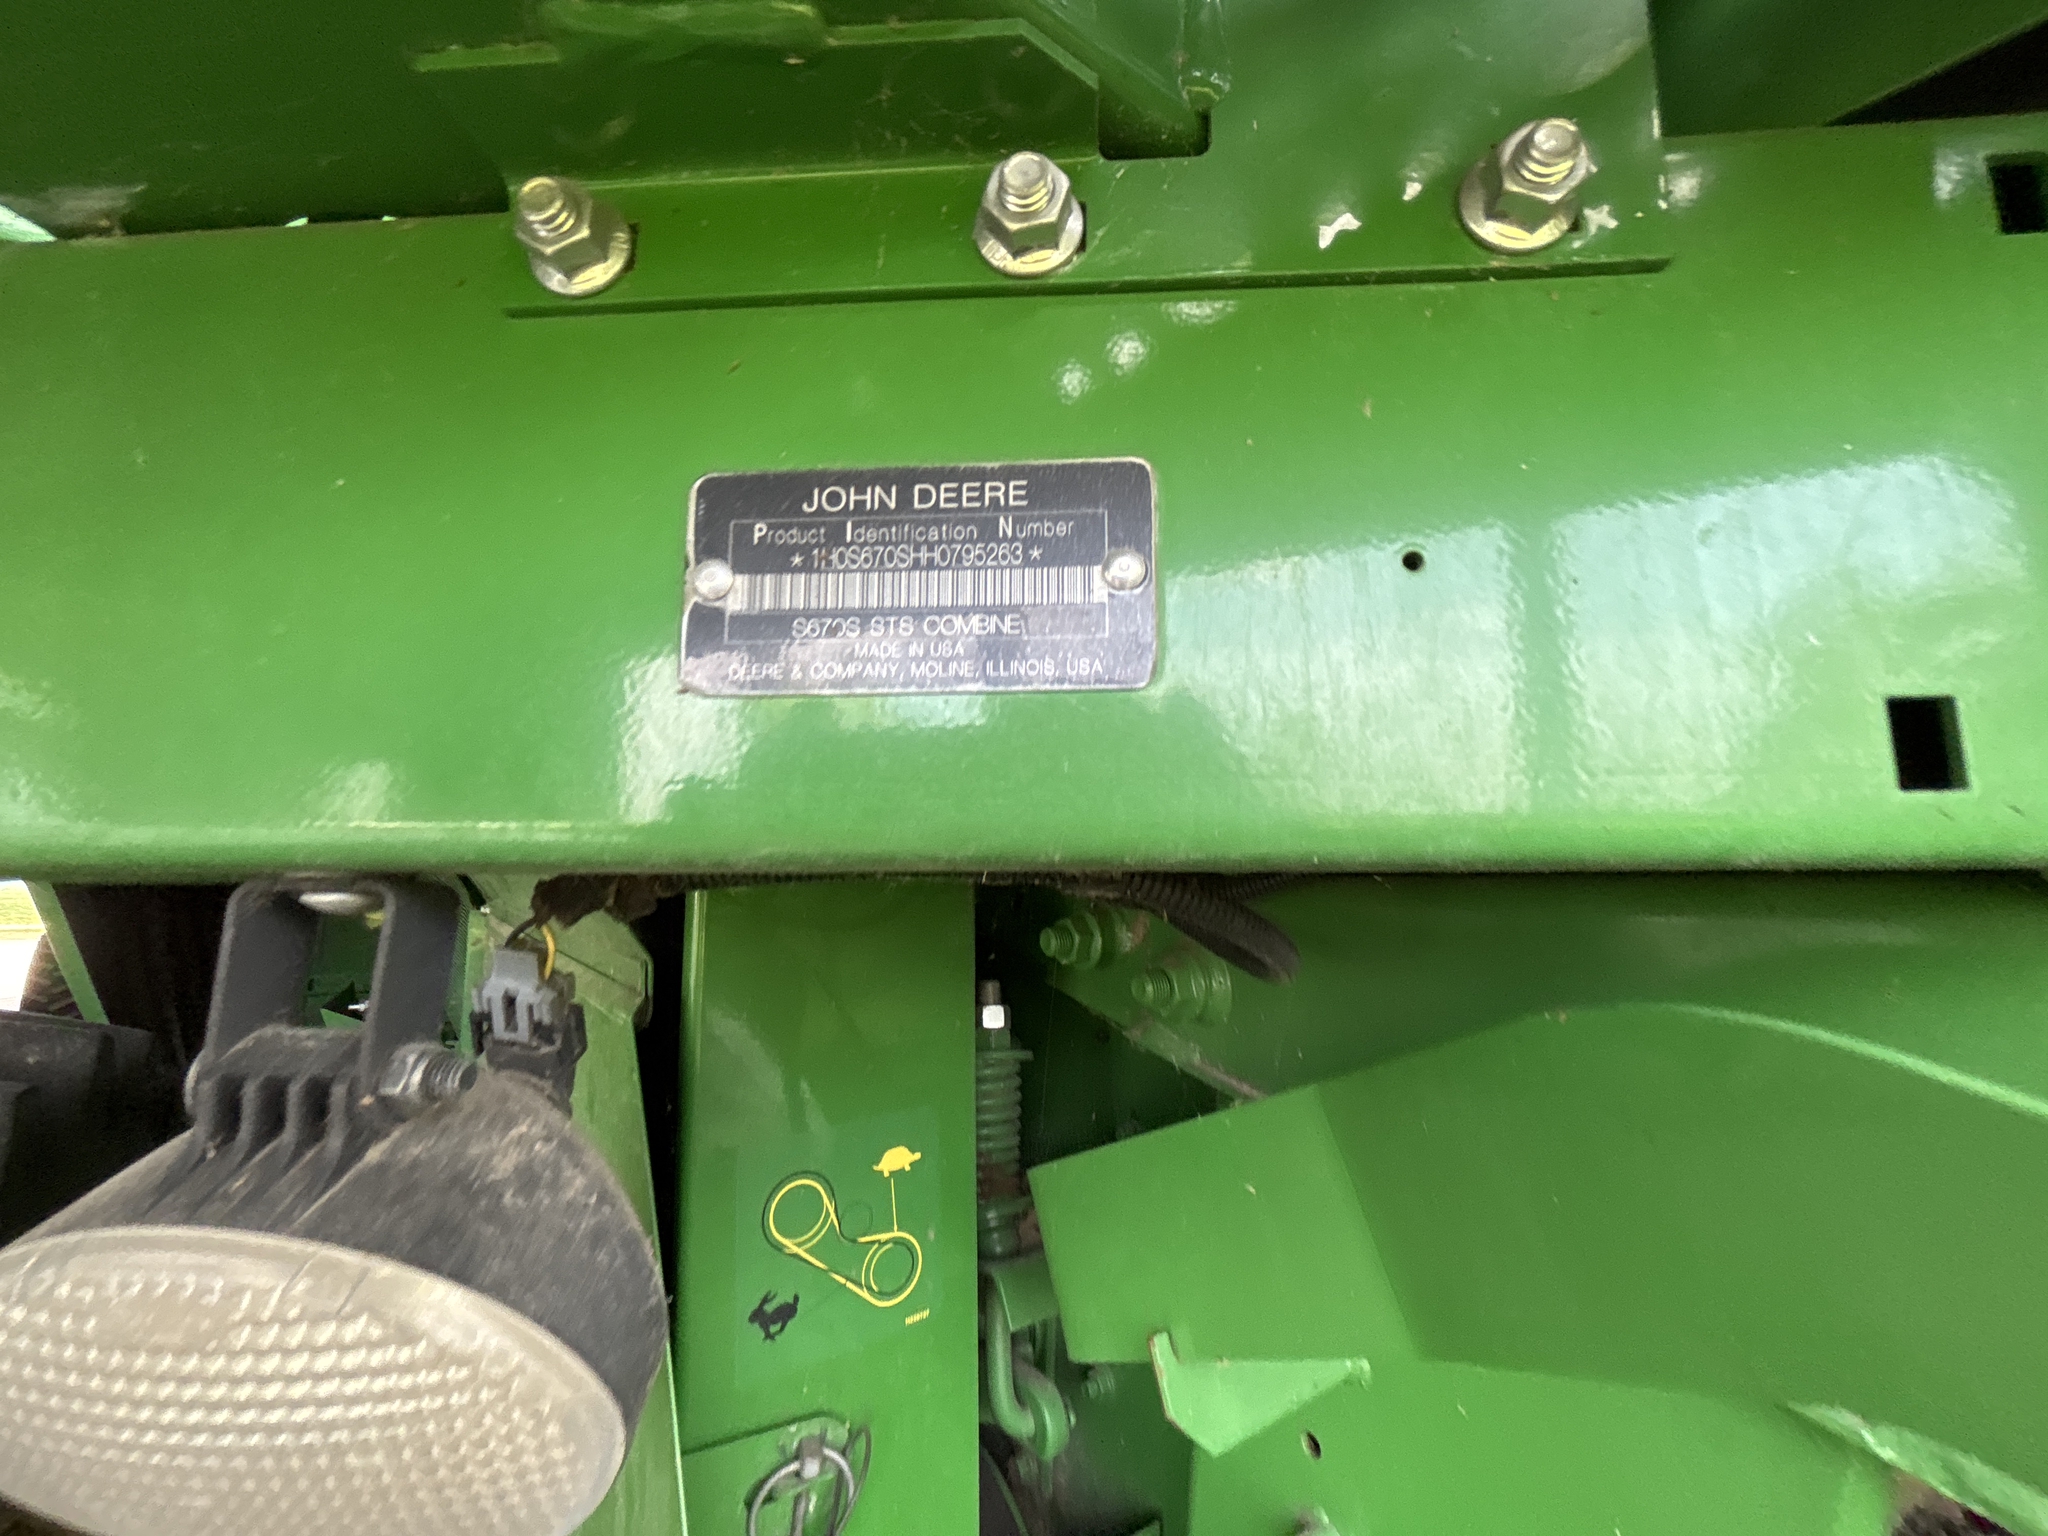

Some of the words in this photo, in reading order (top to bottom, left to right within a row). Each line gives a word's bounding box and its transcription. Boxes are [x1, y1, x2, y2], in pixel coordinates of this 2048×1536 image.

[802, 485, 896, 512] JOHN
[913, 480, 1028, 508] DEERE
[752, 522, 826, 545] Product
[846, 518, 977, 543] Identification
[999, 514, 1074, 538] Number
[870, 615, 914, 638] STS
[923, 613, 1021, 637] COMBINE
[854, 642, 902, 659] MADE
[909, 641, 924, 658] IN
[930, 640, 964, 657] USA
[729, 663, 783, 681] DEERE
[792, 664, 803, 680] &
[810, 660, 904, 682] COMPANY,
[911, 659, 979, 680] MOLINE,
[986, 658, 1059, 678] ILLINOIS,
[1066, 657, 1103, 676] USA
